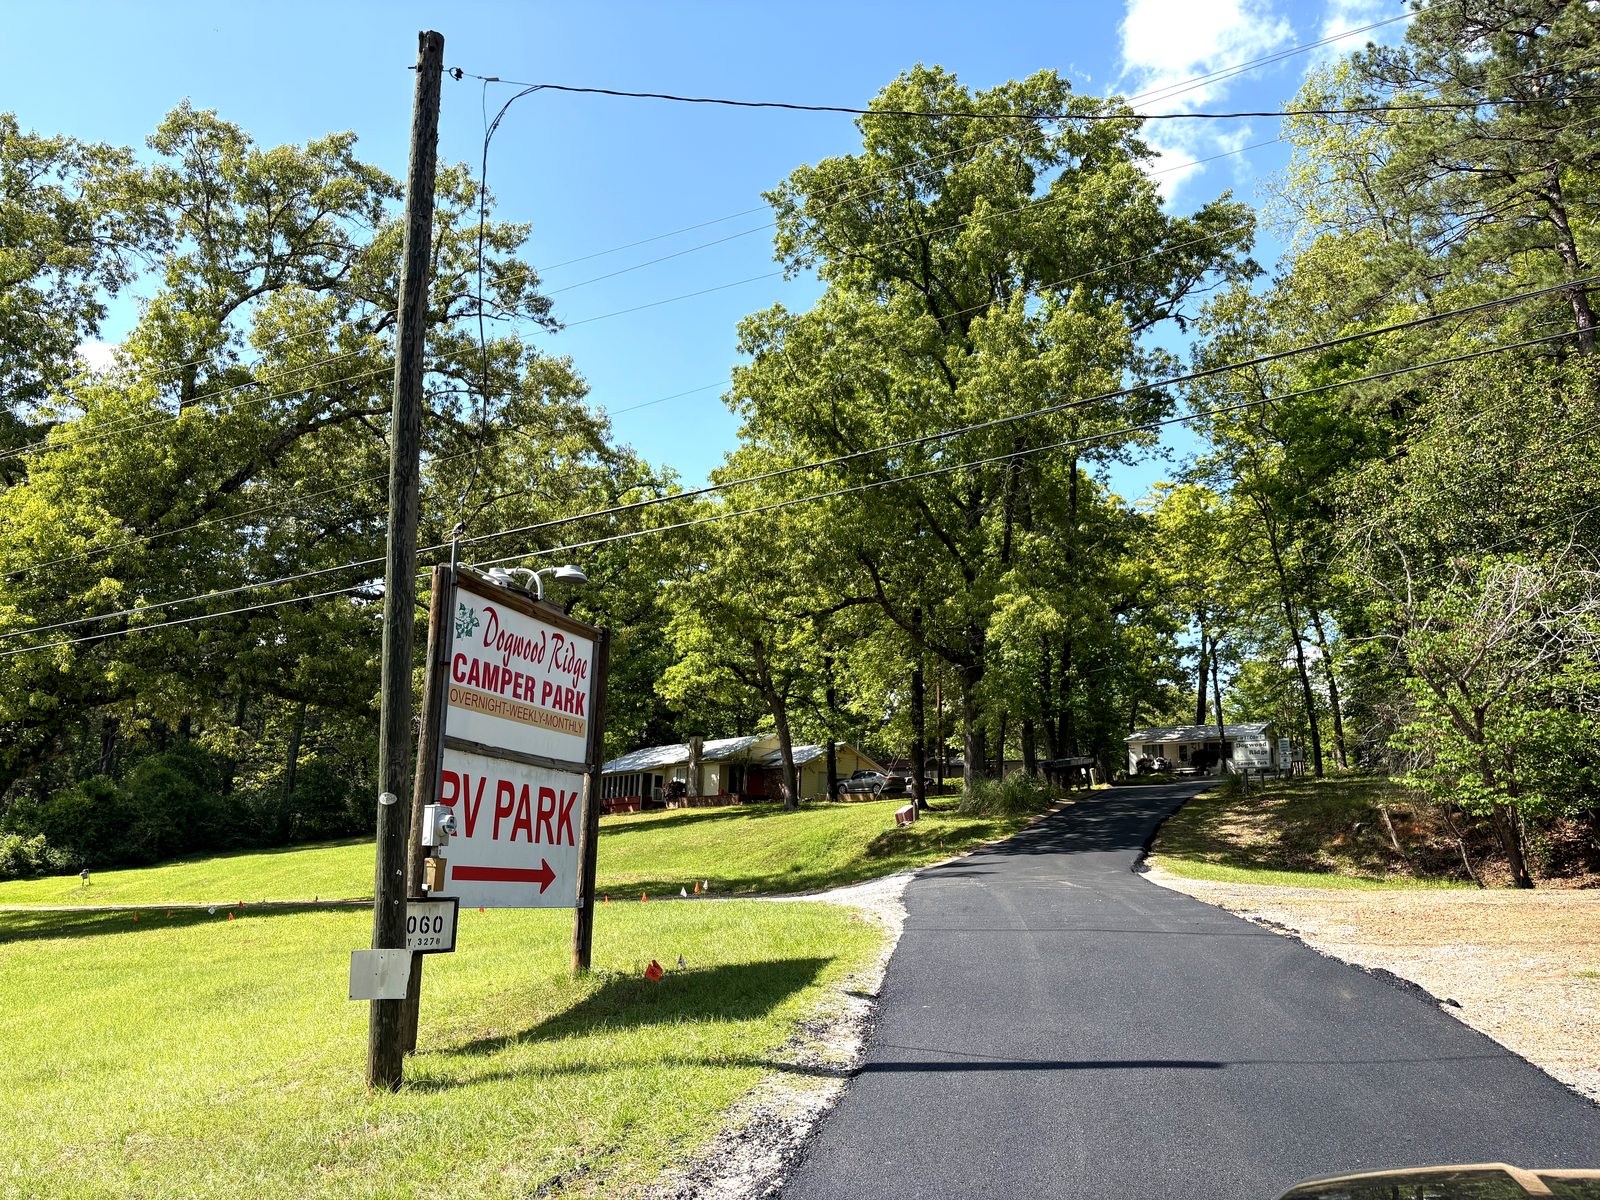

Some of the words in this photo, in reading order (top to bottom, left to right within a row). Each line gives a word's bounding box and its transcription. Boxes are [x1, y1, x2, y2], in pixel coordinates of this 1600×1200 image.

[483, 606, 547, 667] Dogwood
[548, 633, 588, 688] Ridge
[450, 688, 584, 734] OVERNIGHT-WEEKLY-MONTHLY
[452, 652, 536, 703] CAMPER
[541, 680, 586, 717] PARK
[440, 769, 487, 838] RV
[492, 779, 578, 847] PARK
